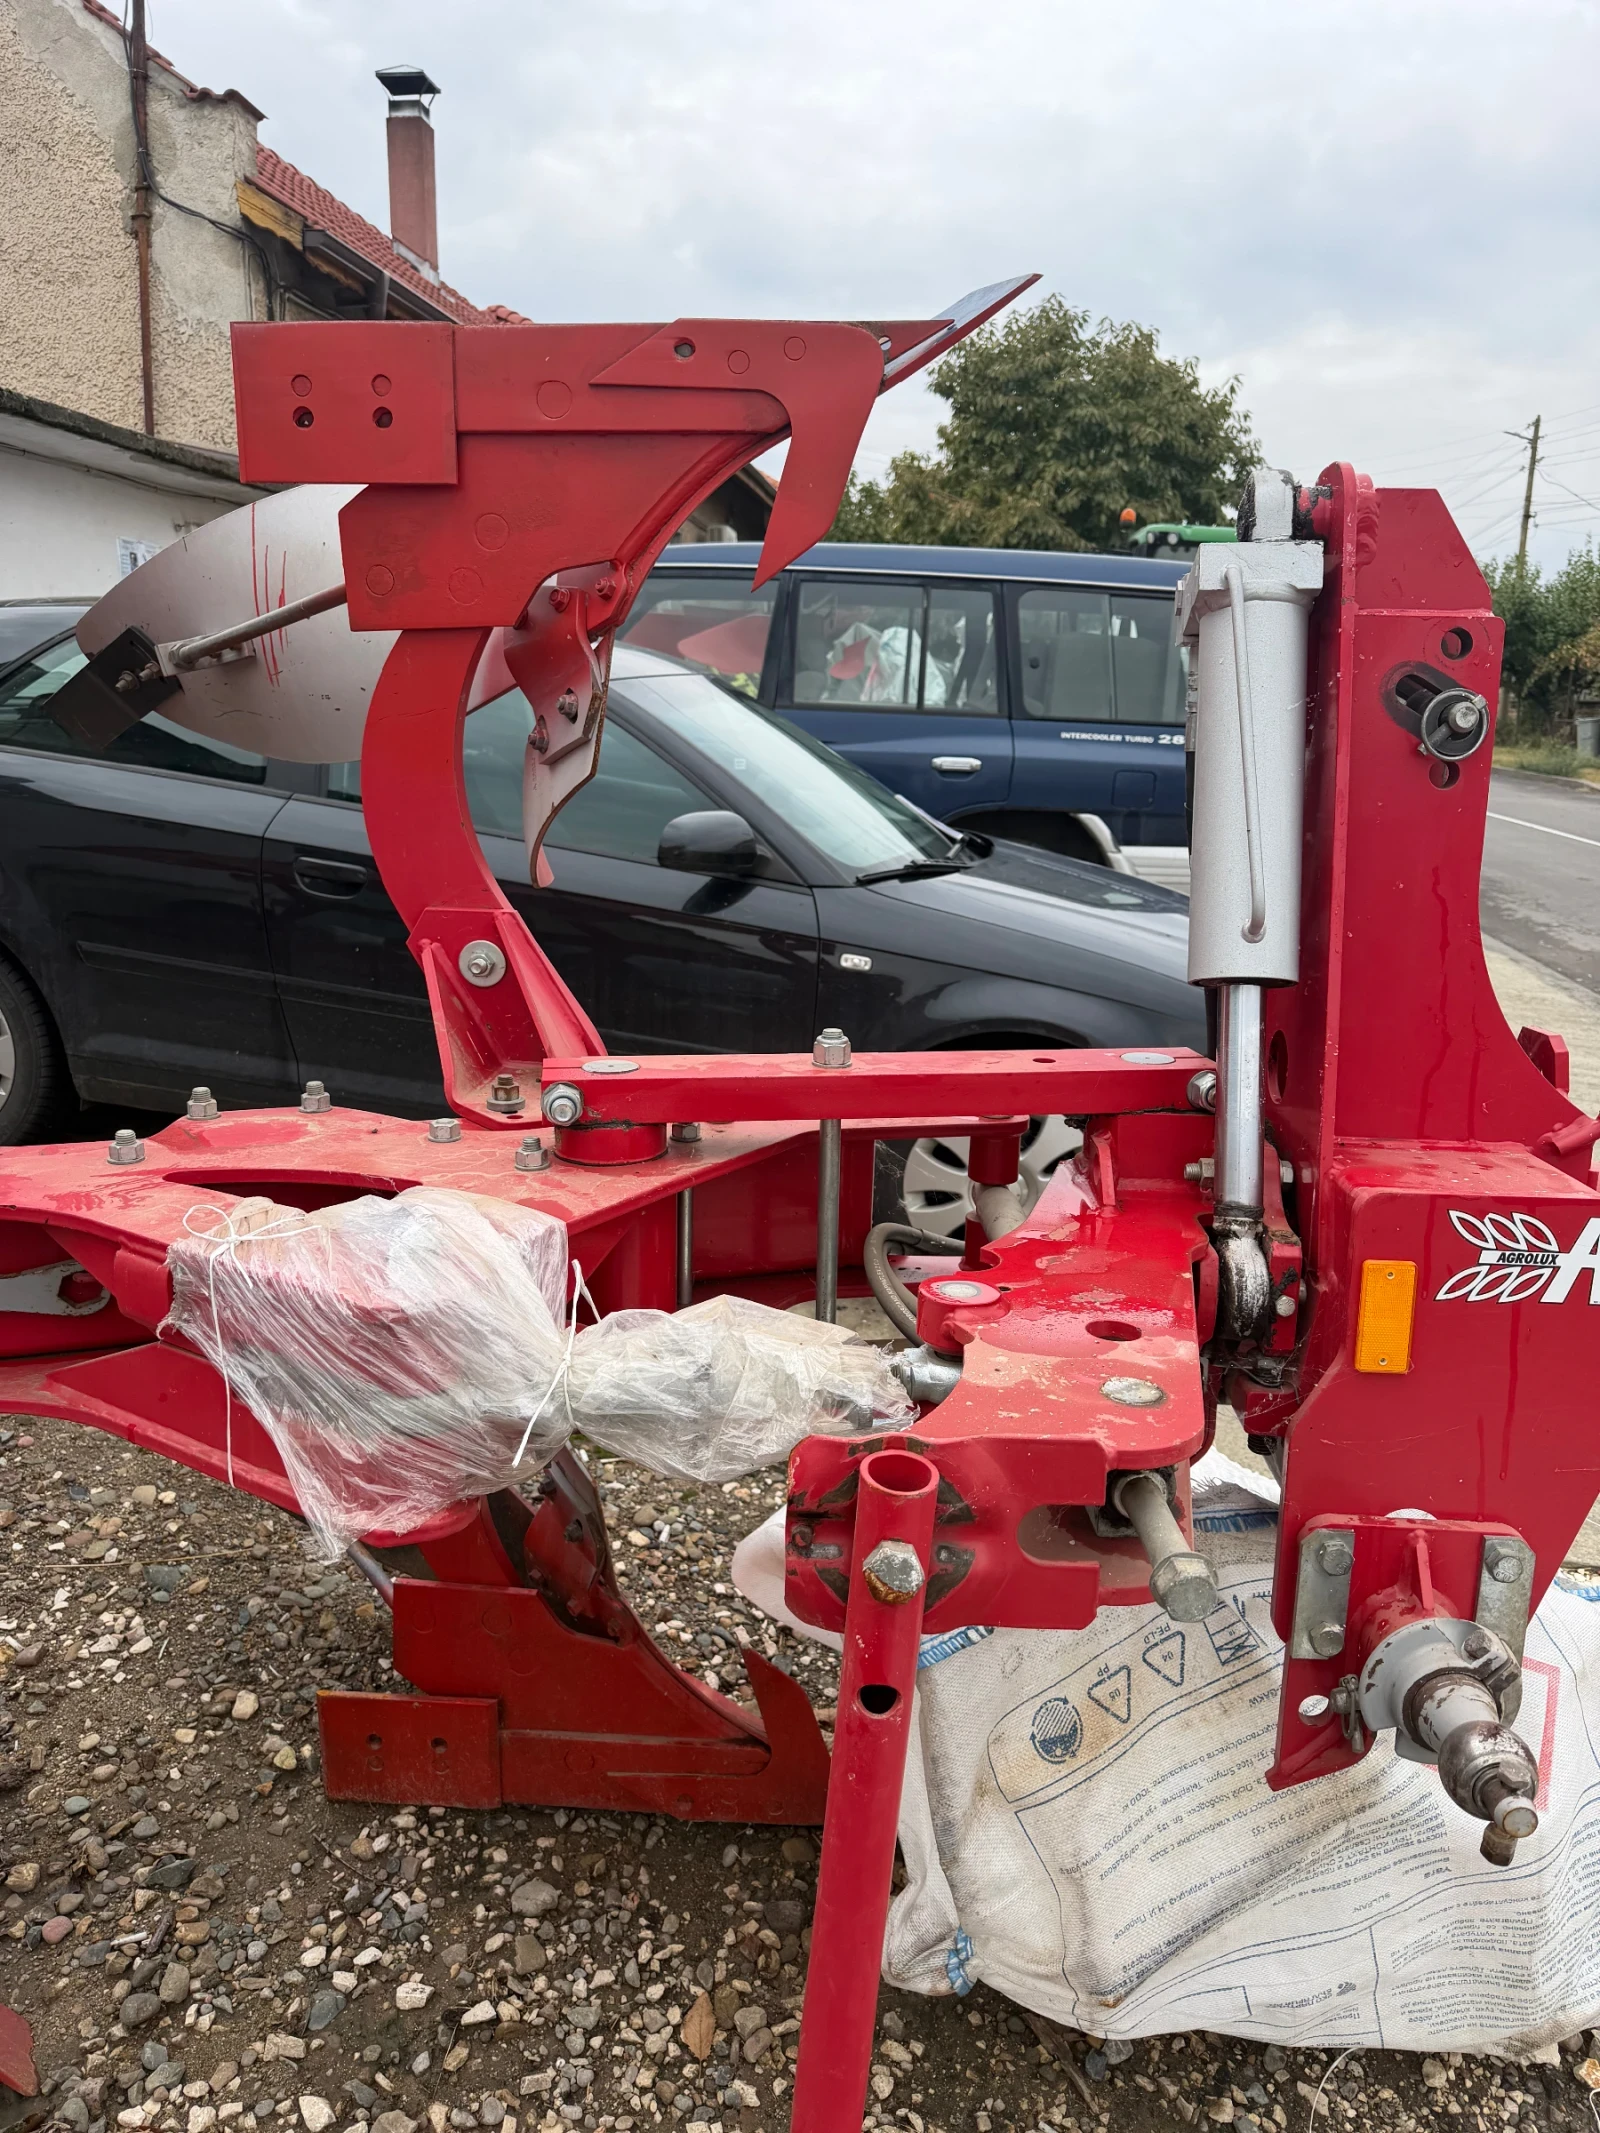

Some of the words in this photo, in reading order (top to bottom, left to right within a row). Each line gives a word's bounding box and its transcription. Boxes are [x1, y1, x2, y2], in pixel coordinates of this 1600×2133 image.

[1060, 732, 1122, 742] INTERCOOLER
[1124, 735, 1154, 743] TURBO
[1497, 1252, 1559, 1265] AGROLUX
[1142, 1622, 1170, 1643] PE-LD
[1160, 1650, 1174, 1662] 04
[1094, 1662, 1110, 1677] PP
